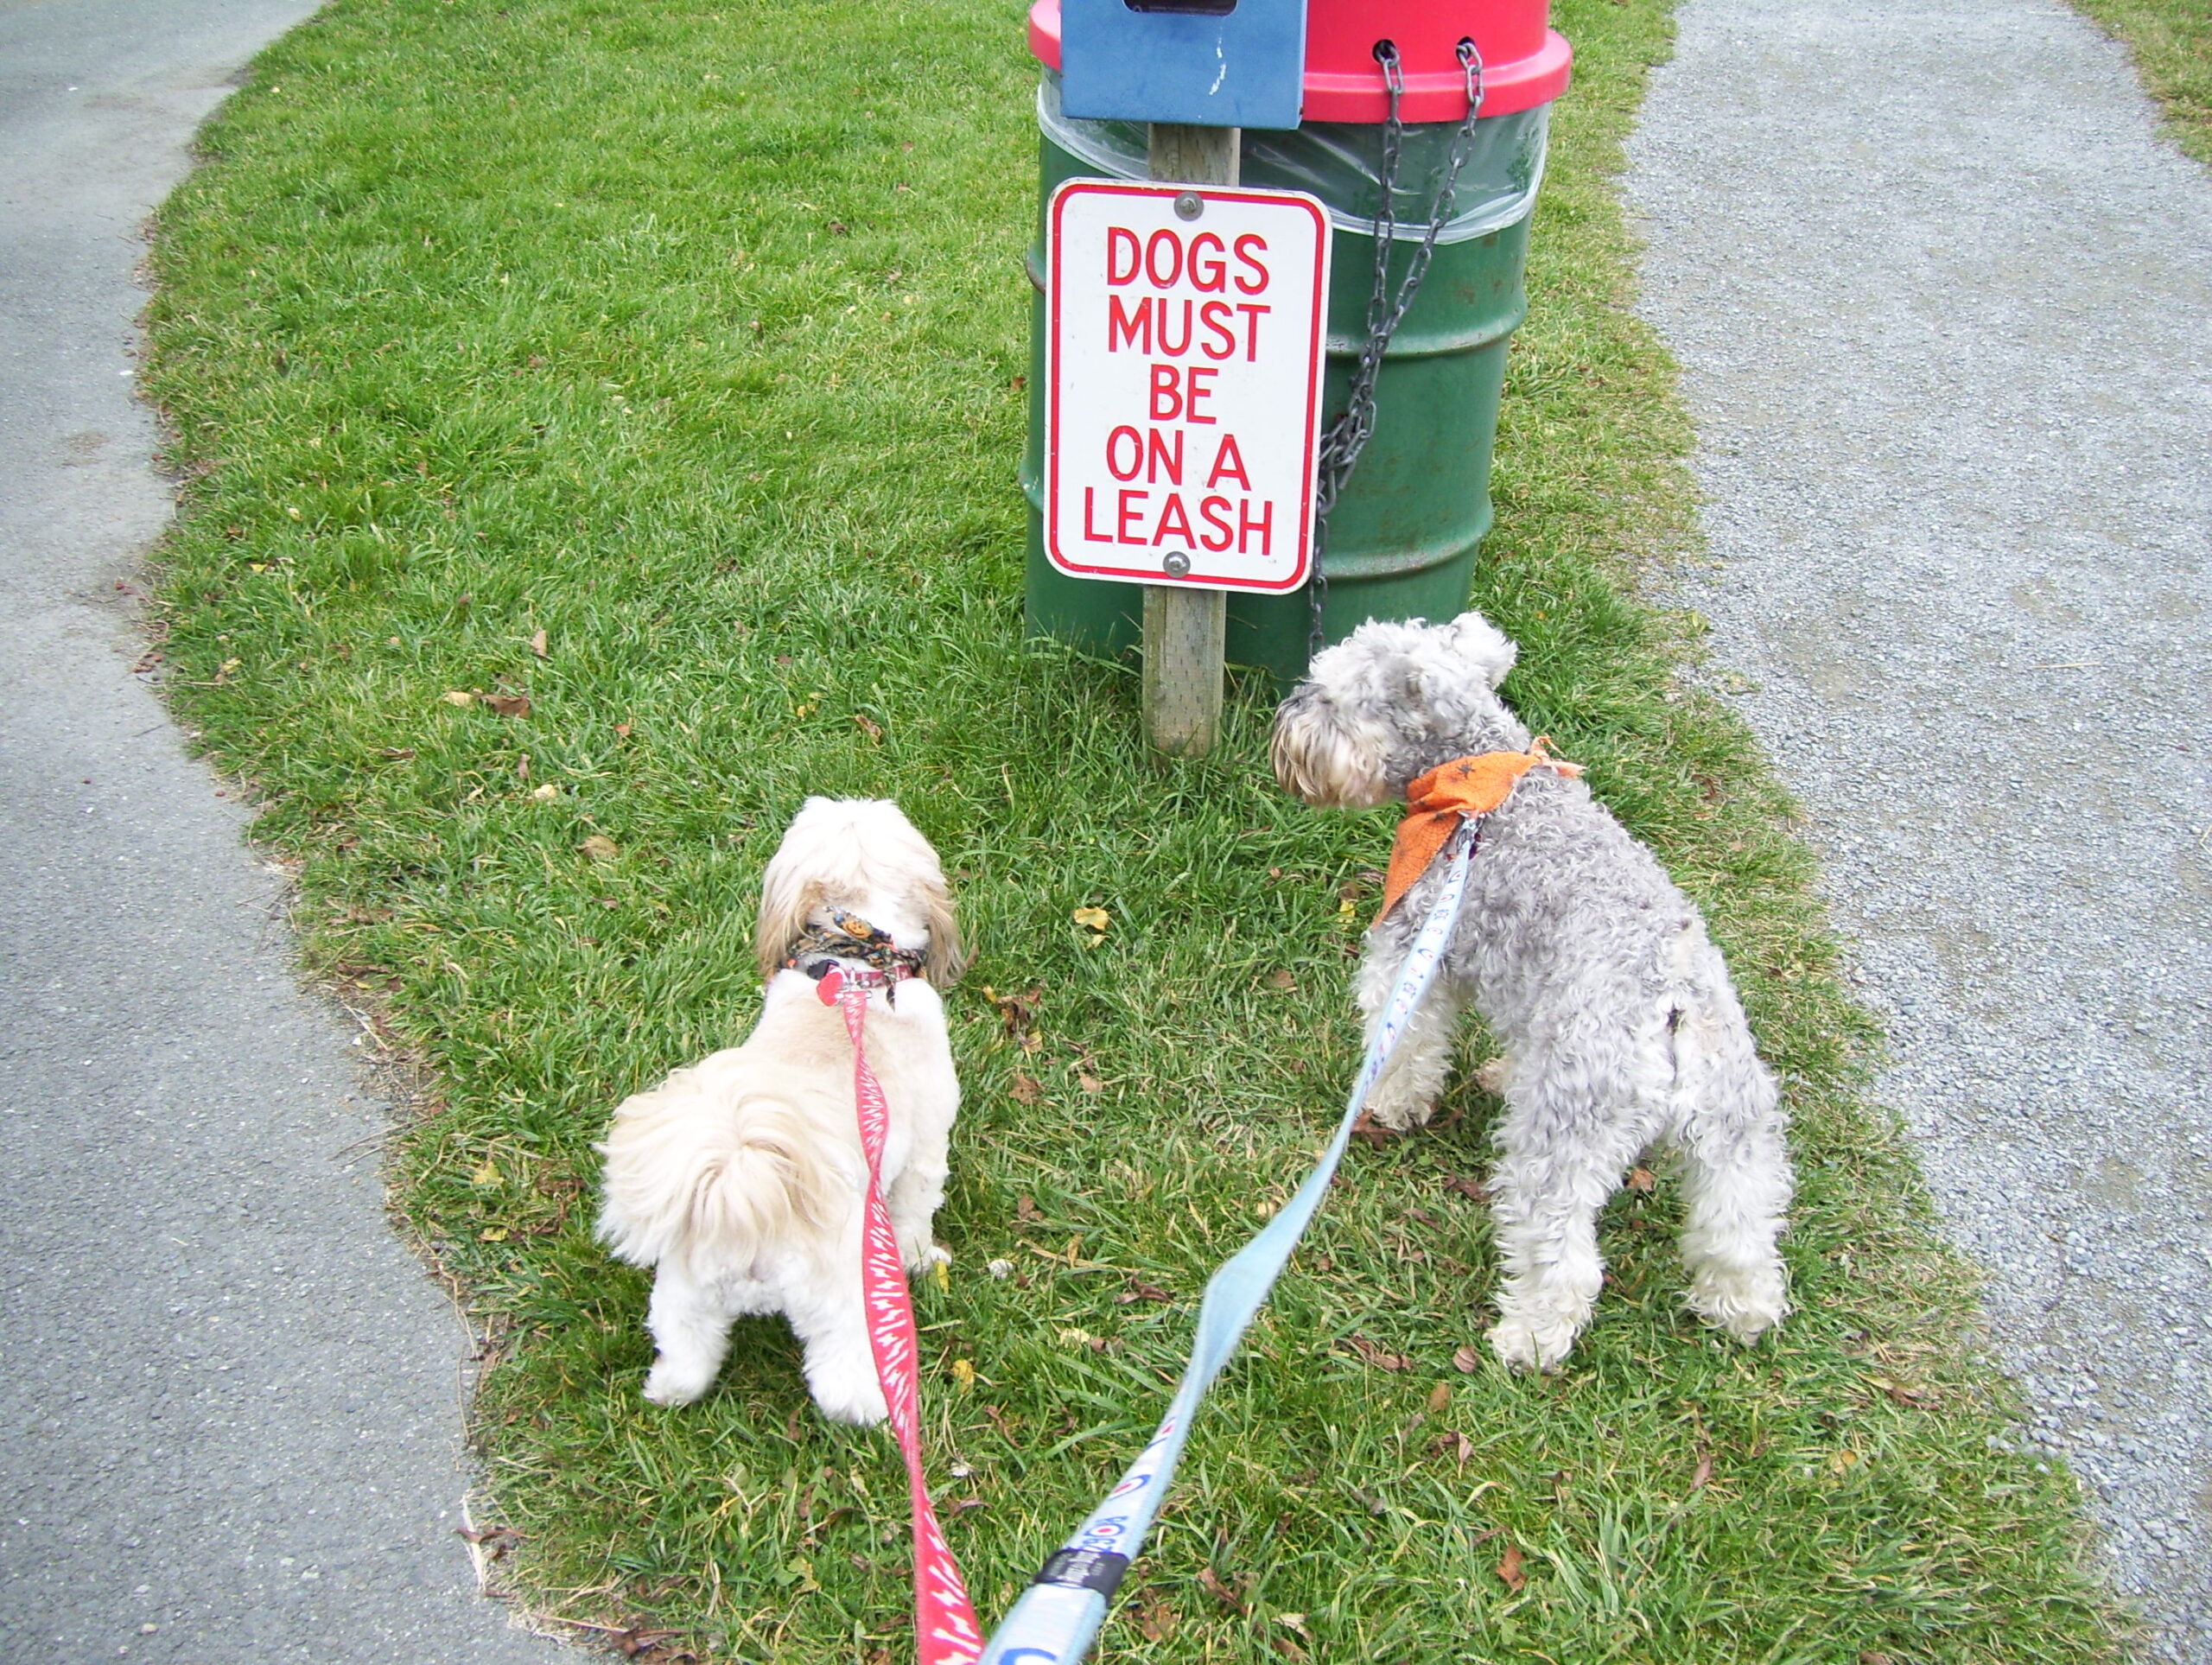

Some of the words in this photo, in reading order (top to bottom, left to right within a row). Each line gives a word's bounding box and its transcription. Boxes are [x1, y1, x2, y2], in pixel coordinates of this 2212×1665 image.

[1107, 226, 1270, 296] DOGS
[1109, 295, 1272, 363] MUST
[1149, 363, 1219, 425] BE
[1106, 424, 1185, 486] ON
[1206, 433, 1252, 492] A
[1084, 486, 1274, 556] LEASH
